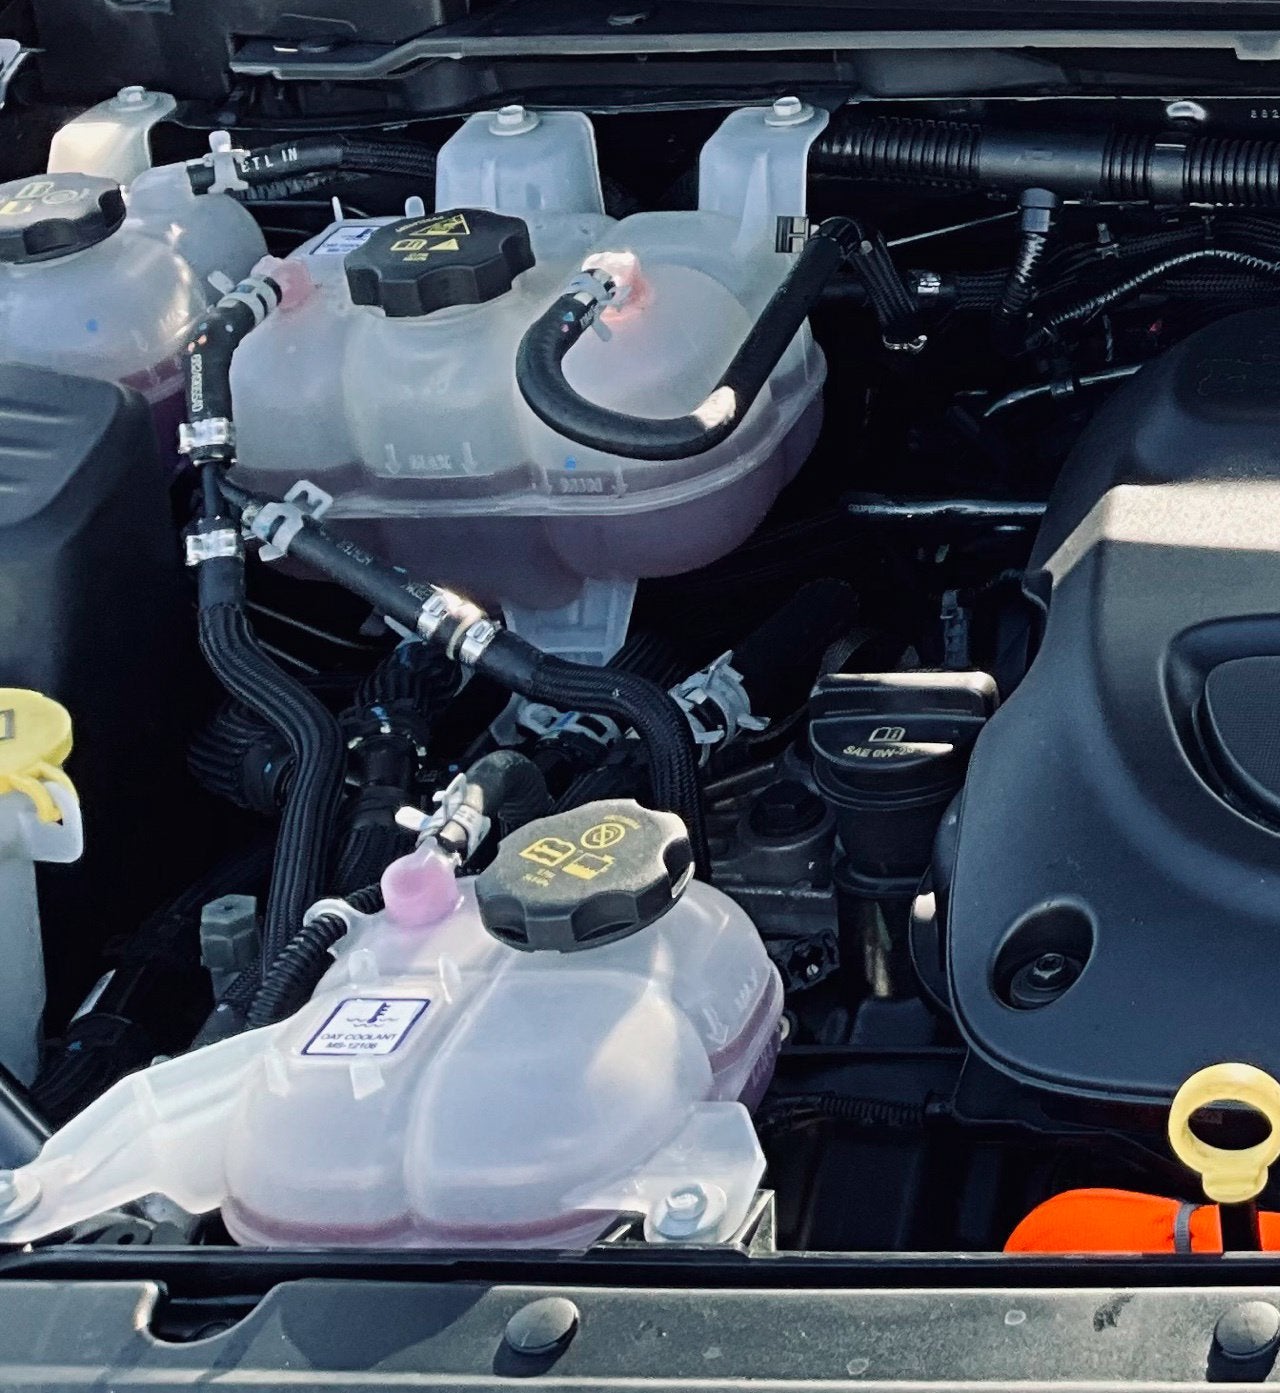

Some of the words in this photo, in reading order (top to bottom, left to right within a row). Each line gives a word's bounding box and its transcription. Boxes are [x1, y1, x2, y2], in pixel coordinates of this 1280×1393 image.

[281, 147, 298, 162] IN
[843, 745, 872, 758] SAE
[321, 1033, 343, 1041] OAT
[344, 1033, 398, 1041] COOLANT
